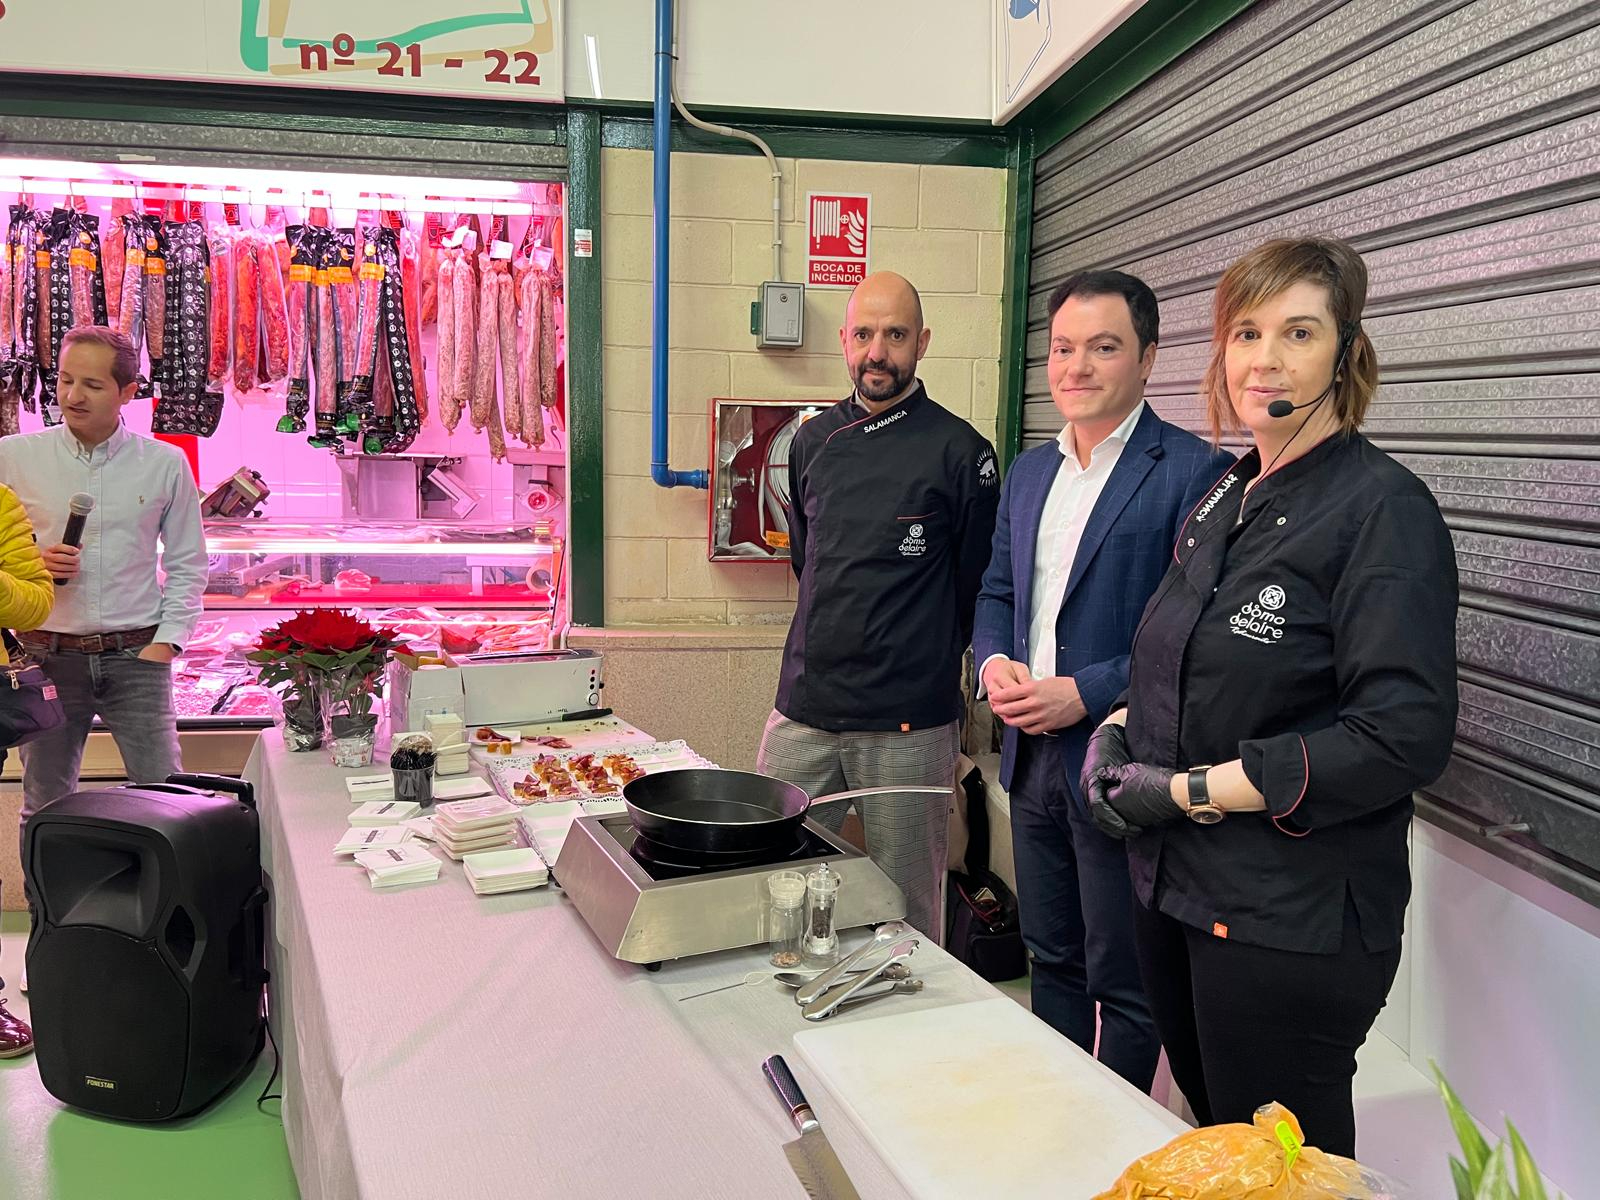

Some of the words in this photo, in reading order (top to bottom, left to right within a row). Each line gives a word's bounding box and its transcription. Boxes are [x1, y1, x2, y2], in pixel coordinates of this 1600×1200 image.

[376, 41, 422, 77] 21
[484, 49, 541, 86] 22
[811, 272, 863, 283] INCENDIO
[813, 263, 845, 273] BOCA
[847, 264, 862, 274] DE
[863, 410, 908, 434] SALAMANCA
[1229, 612, 1283, 639] delaire
